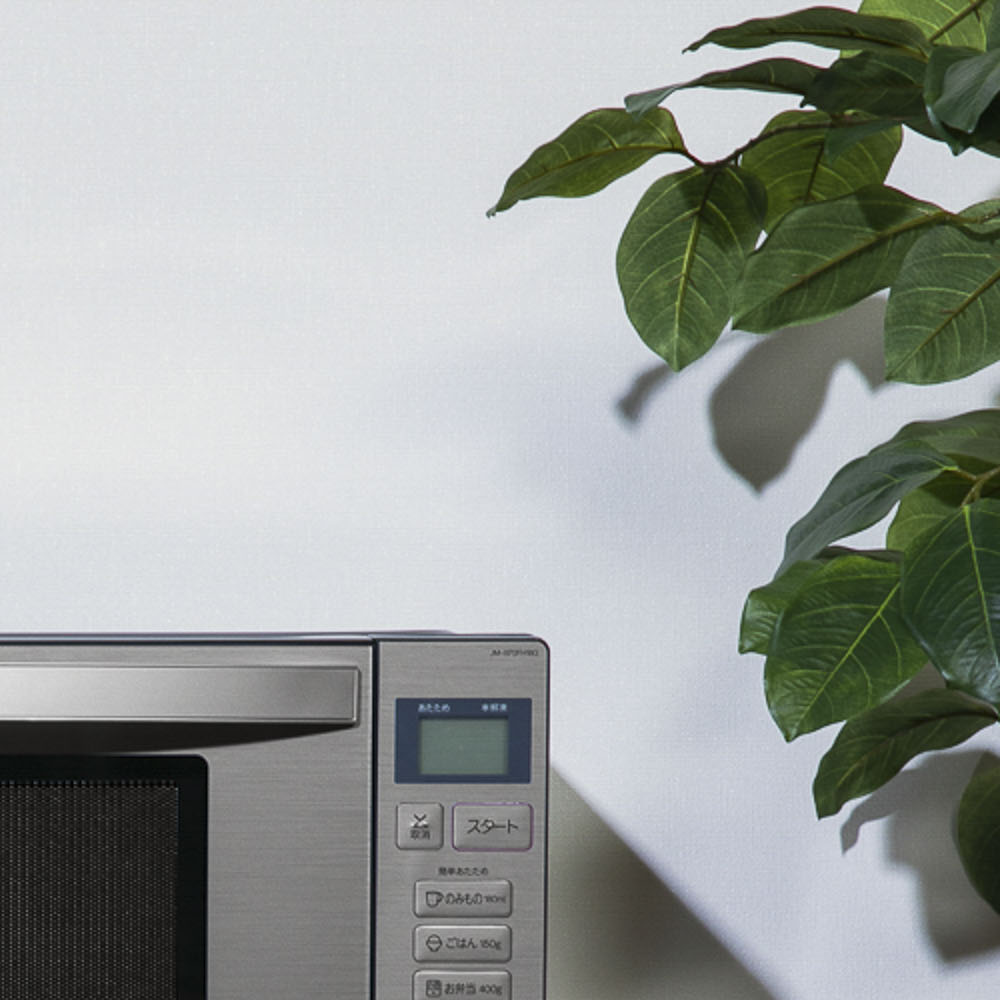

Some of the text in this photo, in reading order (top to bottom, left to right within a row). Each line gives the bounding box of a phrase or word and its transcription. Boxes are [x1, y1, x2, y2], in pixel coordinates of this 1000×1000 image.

[466, 819, 519, 835] スタート
[445, 893, 482, 905] のみもの
[446, 937, 477, 949] ごはん
[444, 983, 476, 995] お弁当
